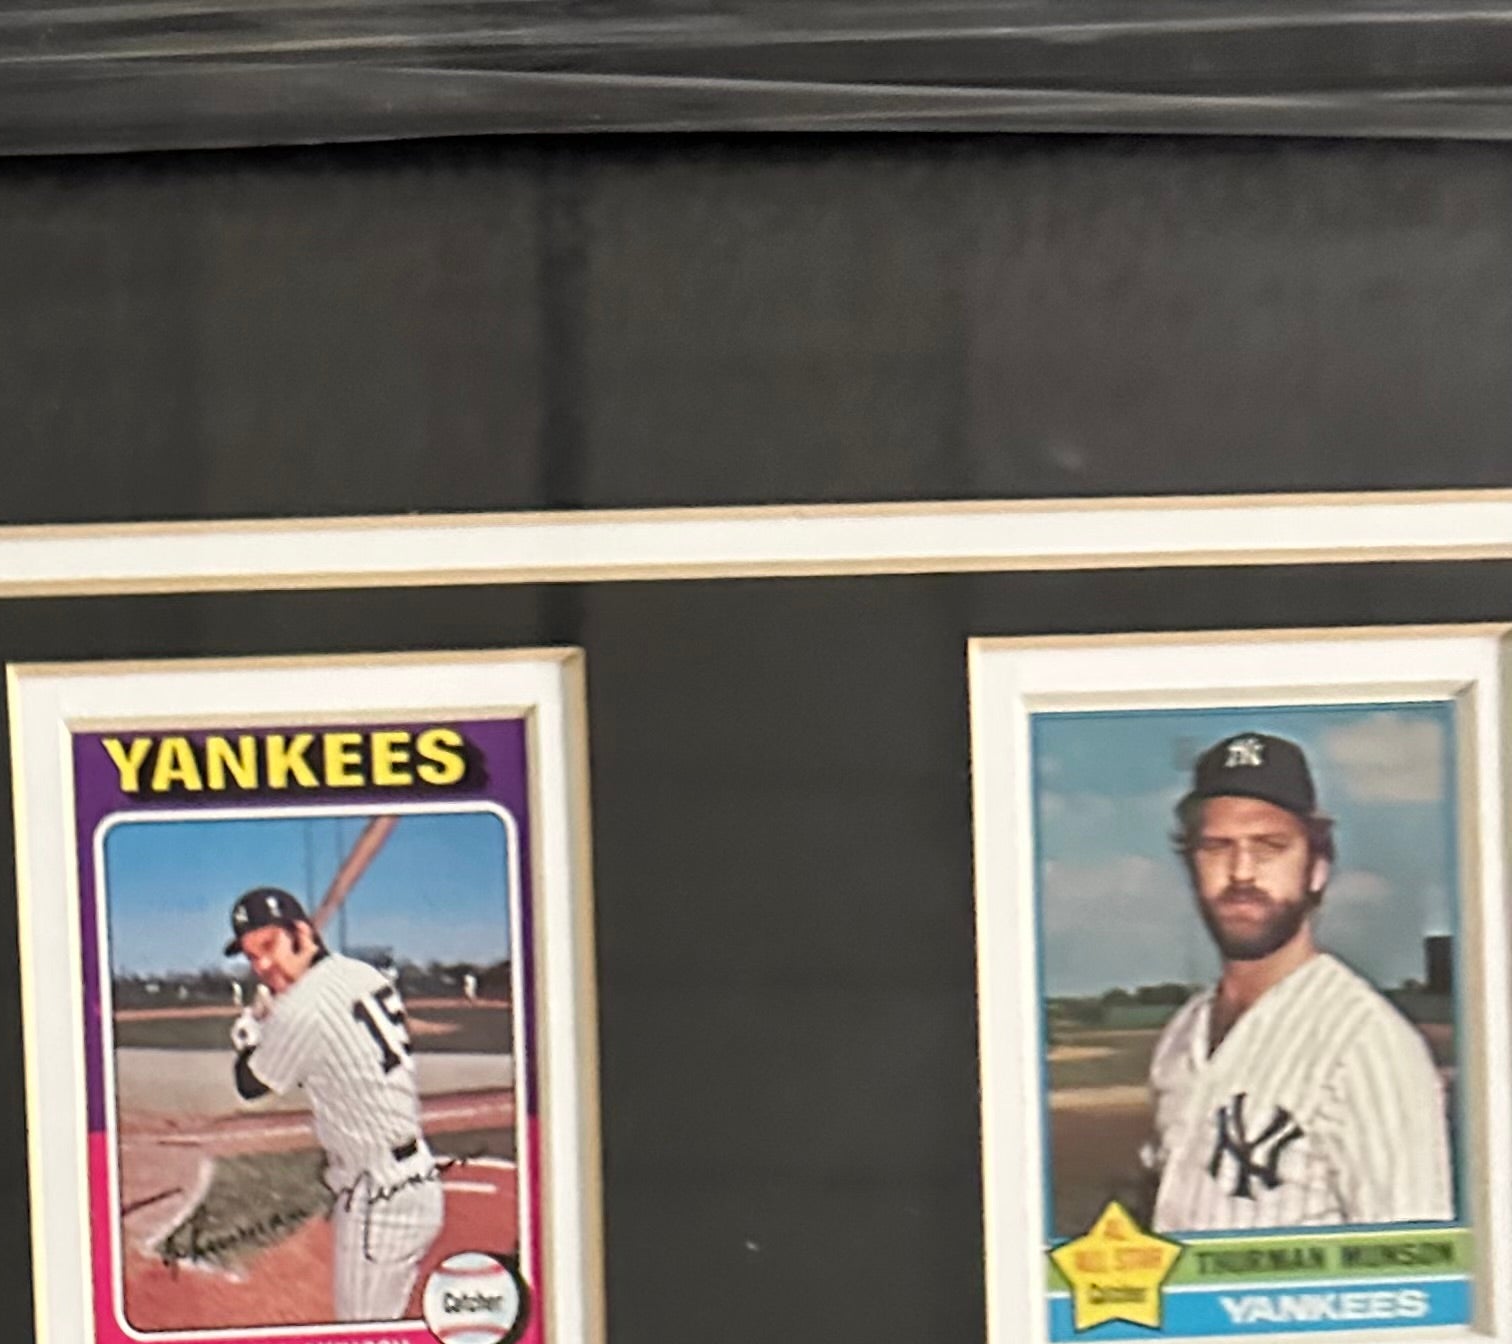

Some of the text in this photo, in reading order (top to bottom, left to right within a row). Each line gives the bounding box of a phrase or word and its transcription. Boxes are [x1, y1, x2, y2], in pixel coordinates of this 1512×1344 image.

[101, 729, 466, 792] YANKEES
[1206, 1091, 1305, 1201] NY
[1220, 1288, 1428, 1324] YANKEES
